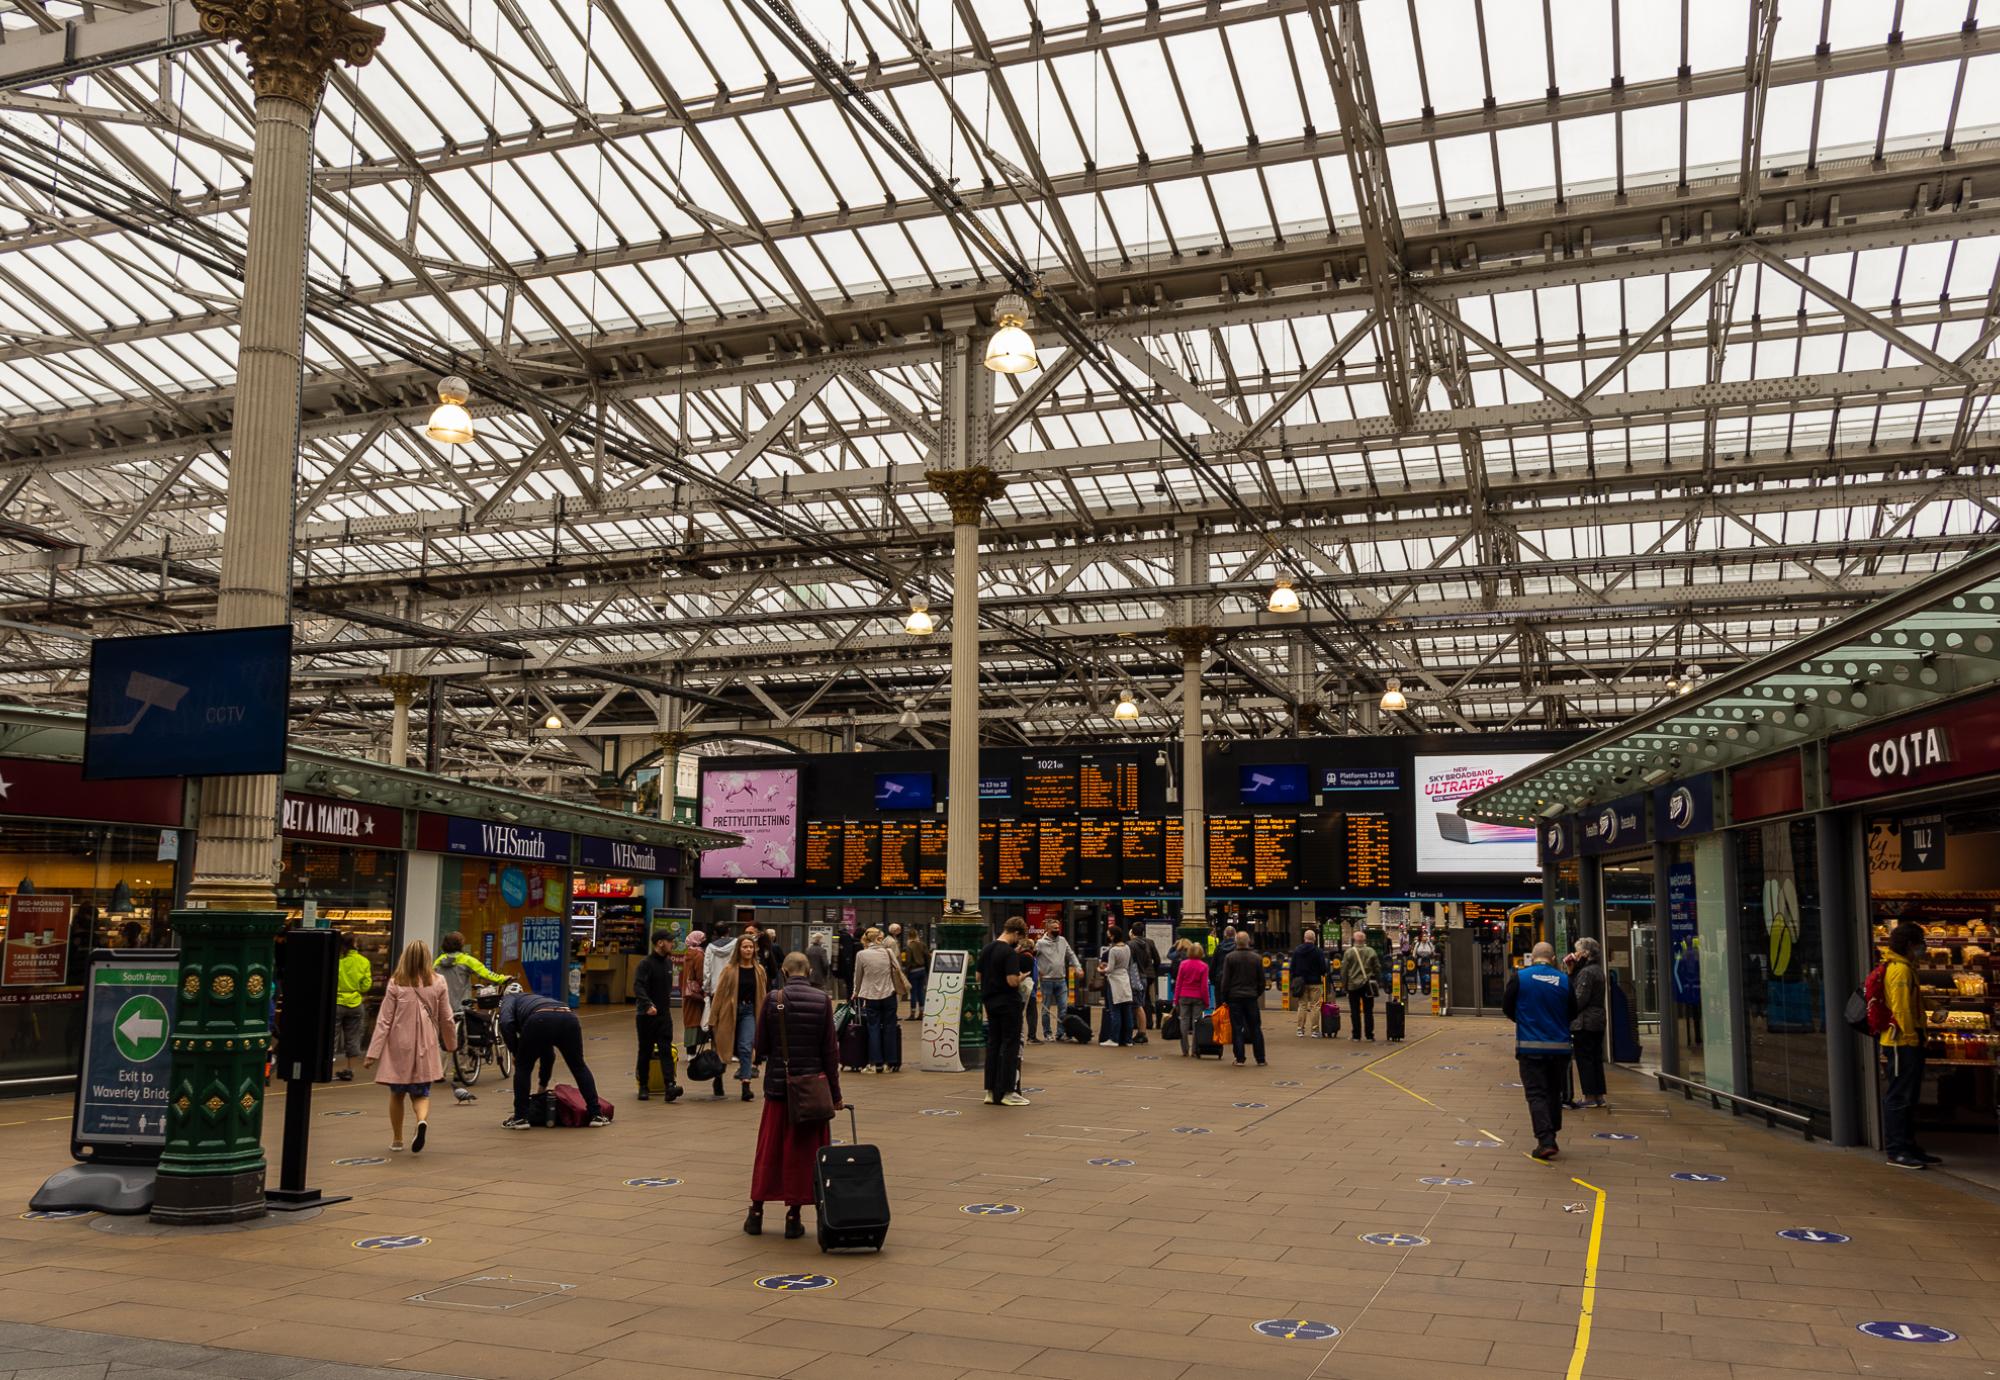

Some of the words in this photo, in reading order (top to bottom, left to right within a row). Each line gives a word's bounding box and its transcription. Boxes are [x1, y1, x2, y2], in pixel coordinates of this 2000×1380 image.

[206, 706, 246, 723] CCTV
[1868, 727, 1942, 778] COSTA
[1038, 760, 1057, 769] 1021
[1446, 769, 1493, 780] BROADBAND
[282, 799, 304, 831] RET
[306, 802, 315, 832] A
[317, 804, 359, 837] MANGER
[713, 815, 790, 827] PRETTYLITTLETHING
[481, 824, 546, 858] WHSmith
[613, 842, 657, 876] WHSmith
[18, 900, 65, 908] MID-MORNING
[522, 926, 531, 941] IT
[532, 926, 560, 940] TASTES
[521, 940, 560, 962] MAGIC
[122, 971, 145, 981] South
[146, 972, 168, 983] Ramp
[28, 993, 73, 1001] AMERICANO
[119, 1070, 139, 1083] Exit
[141, 1071, 154, 1083] to
[92, 1085, 140, 1101] Waverley
[143, 1086, 170, 1103] Bridg
